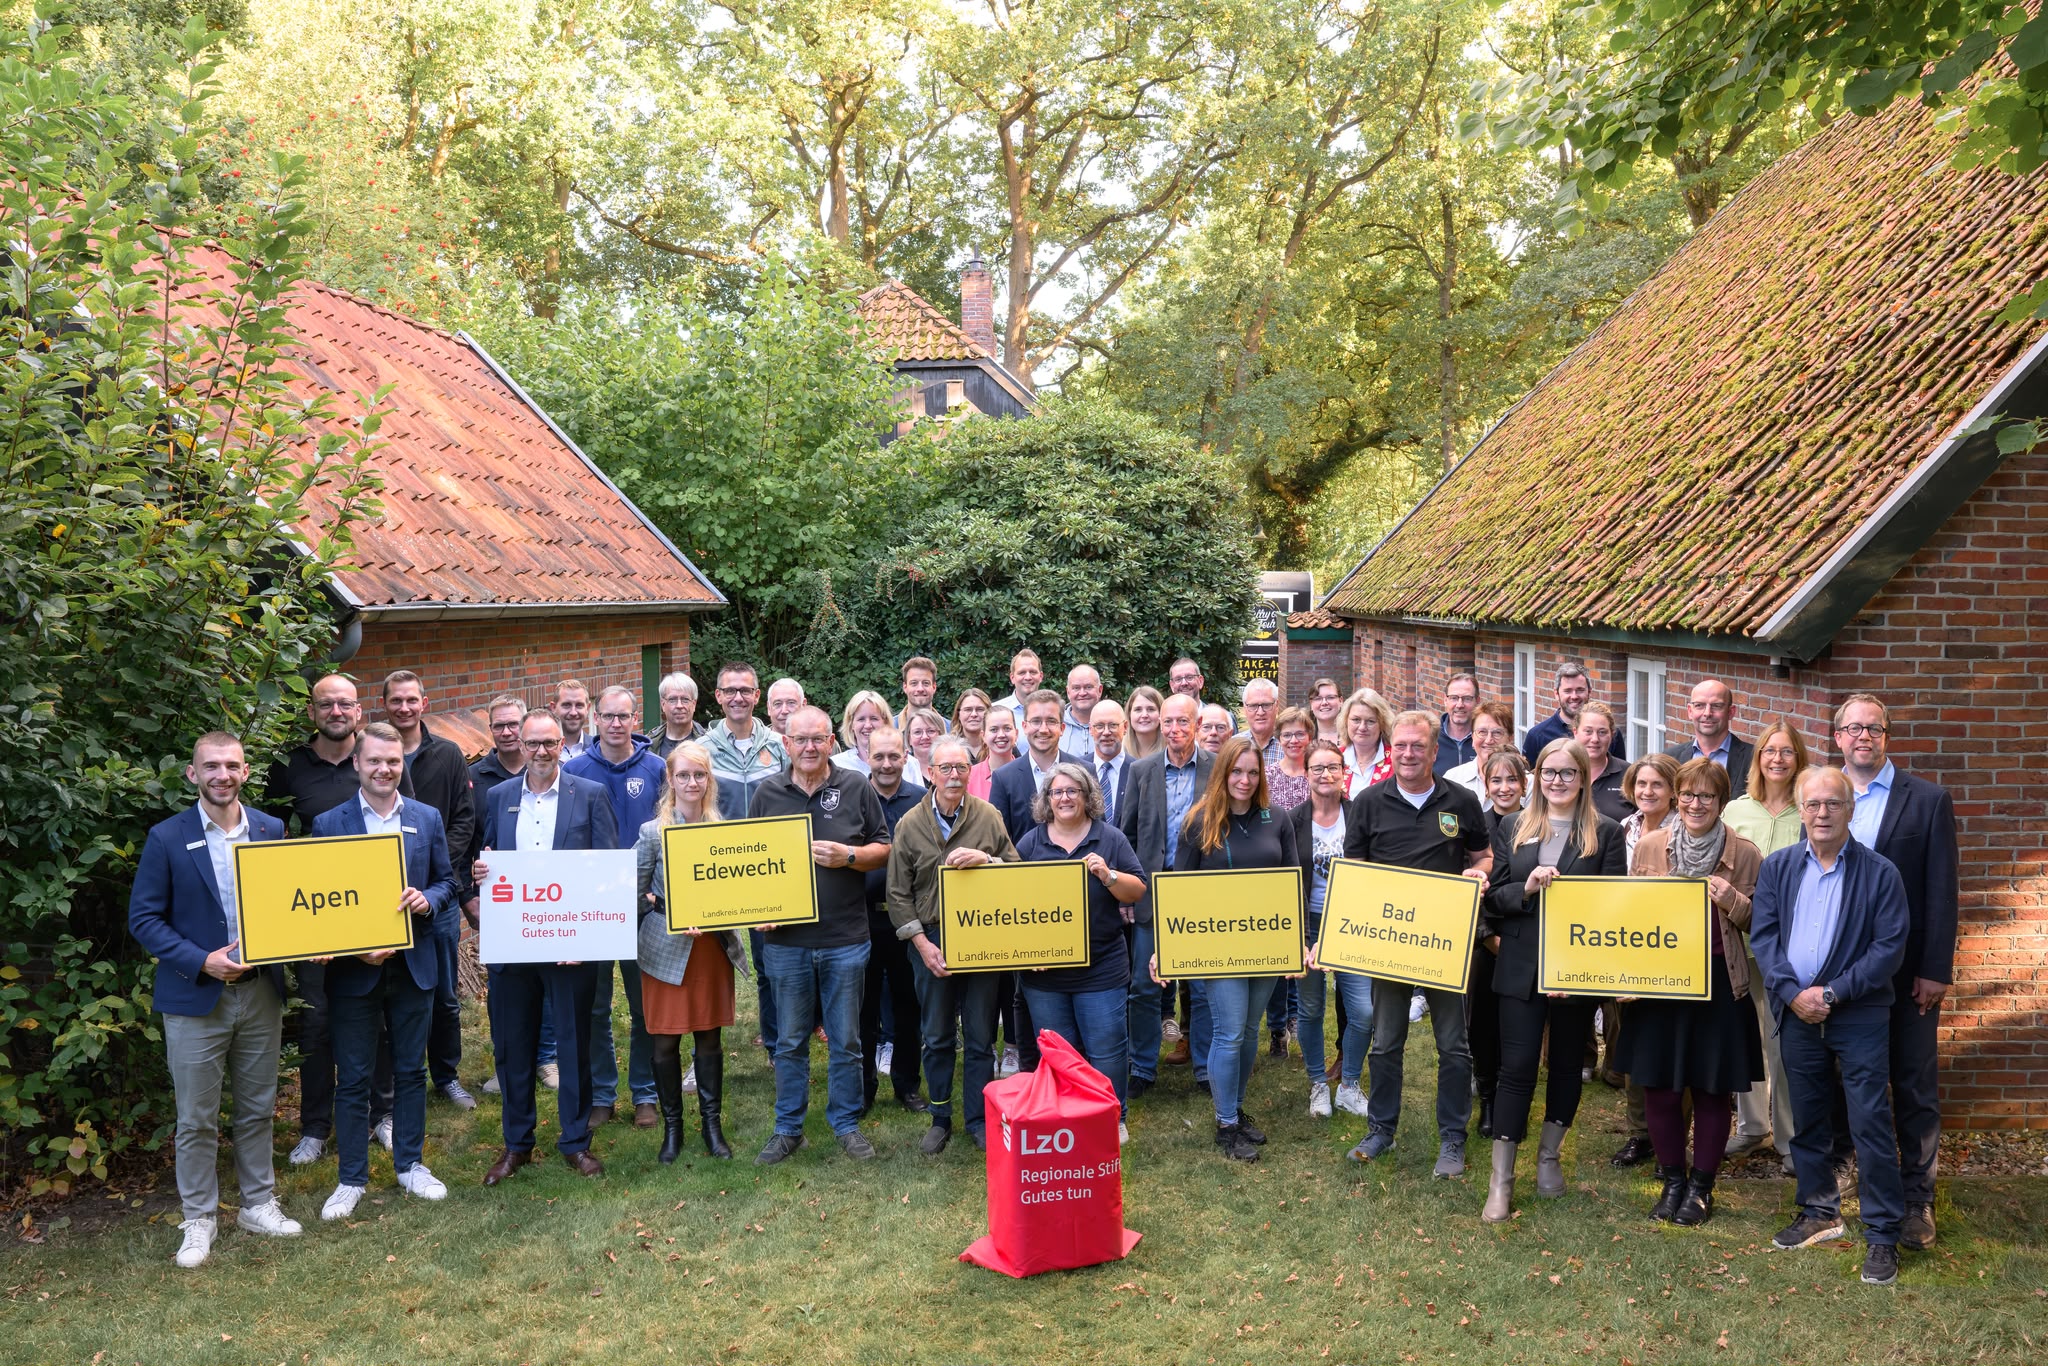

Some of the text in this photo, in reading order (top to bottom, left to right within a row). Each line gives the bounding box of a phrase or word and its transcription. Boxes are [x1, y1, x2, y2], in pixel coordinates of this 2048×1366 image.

[1238, 659, 1279, 669] TAKE-A
[1238, 670, 1278, 679] STREETF
[709, 841, 768, 856] Gemeinde
[693, 857, 787, 882] Edewecht
[291, 888, 359, 916] Apen
[522, 883, 563, 903] LzO
[522, 910, 626, 925] Regionale Stiftung
[702, 904, 783, 919] Landkreis Ammerland
[956, 905, 1073, 928] Wiefelstede
[1382, 902, 1416, 922] Bad
[522, 926, 577, 938] Gutes tun
[1166, 913, 1292, 935] Westerstede
[1339, 917, 1453, 952] Zwischenahn
[1569, 924, 1678, 949] Rastede
[957, 946, 1074, 962] Landkreis Ammerland
[1172, 954, 1289, 969] Landkreis Ammerland
[1339, 952, 1443, 978] Landkreis Ammerland
[1557, 971, 1691, 987] Landkreis Ammerland
[1020, 1128, 1075, 1155] LzO
[1021, 1165, 1095, 1185] Regionale
[1021, 1187, 1092, 1205] Gutes tun
